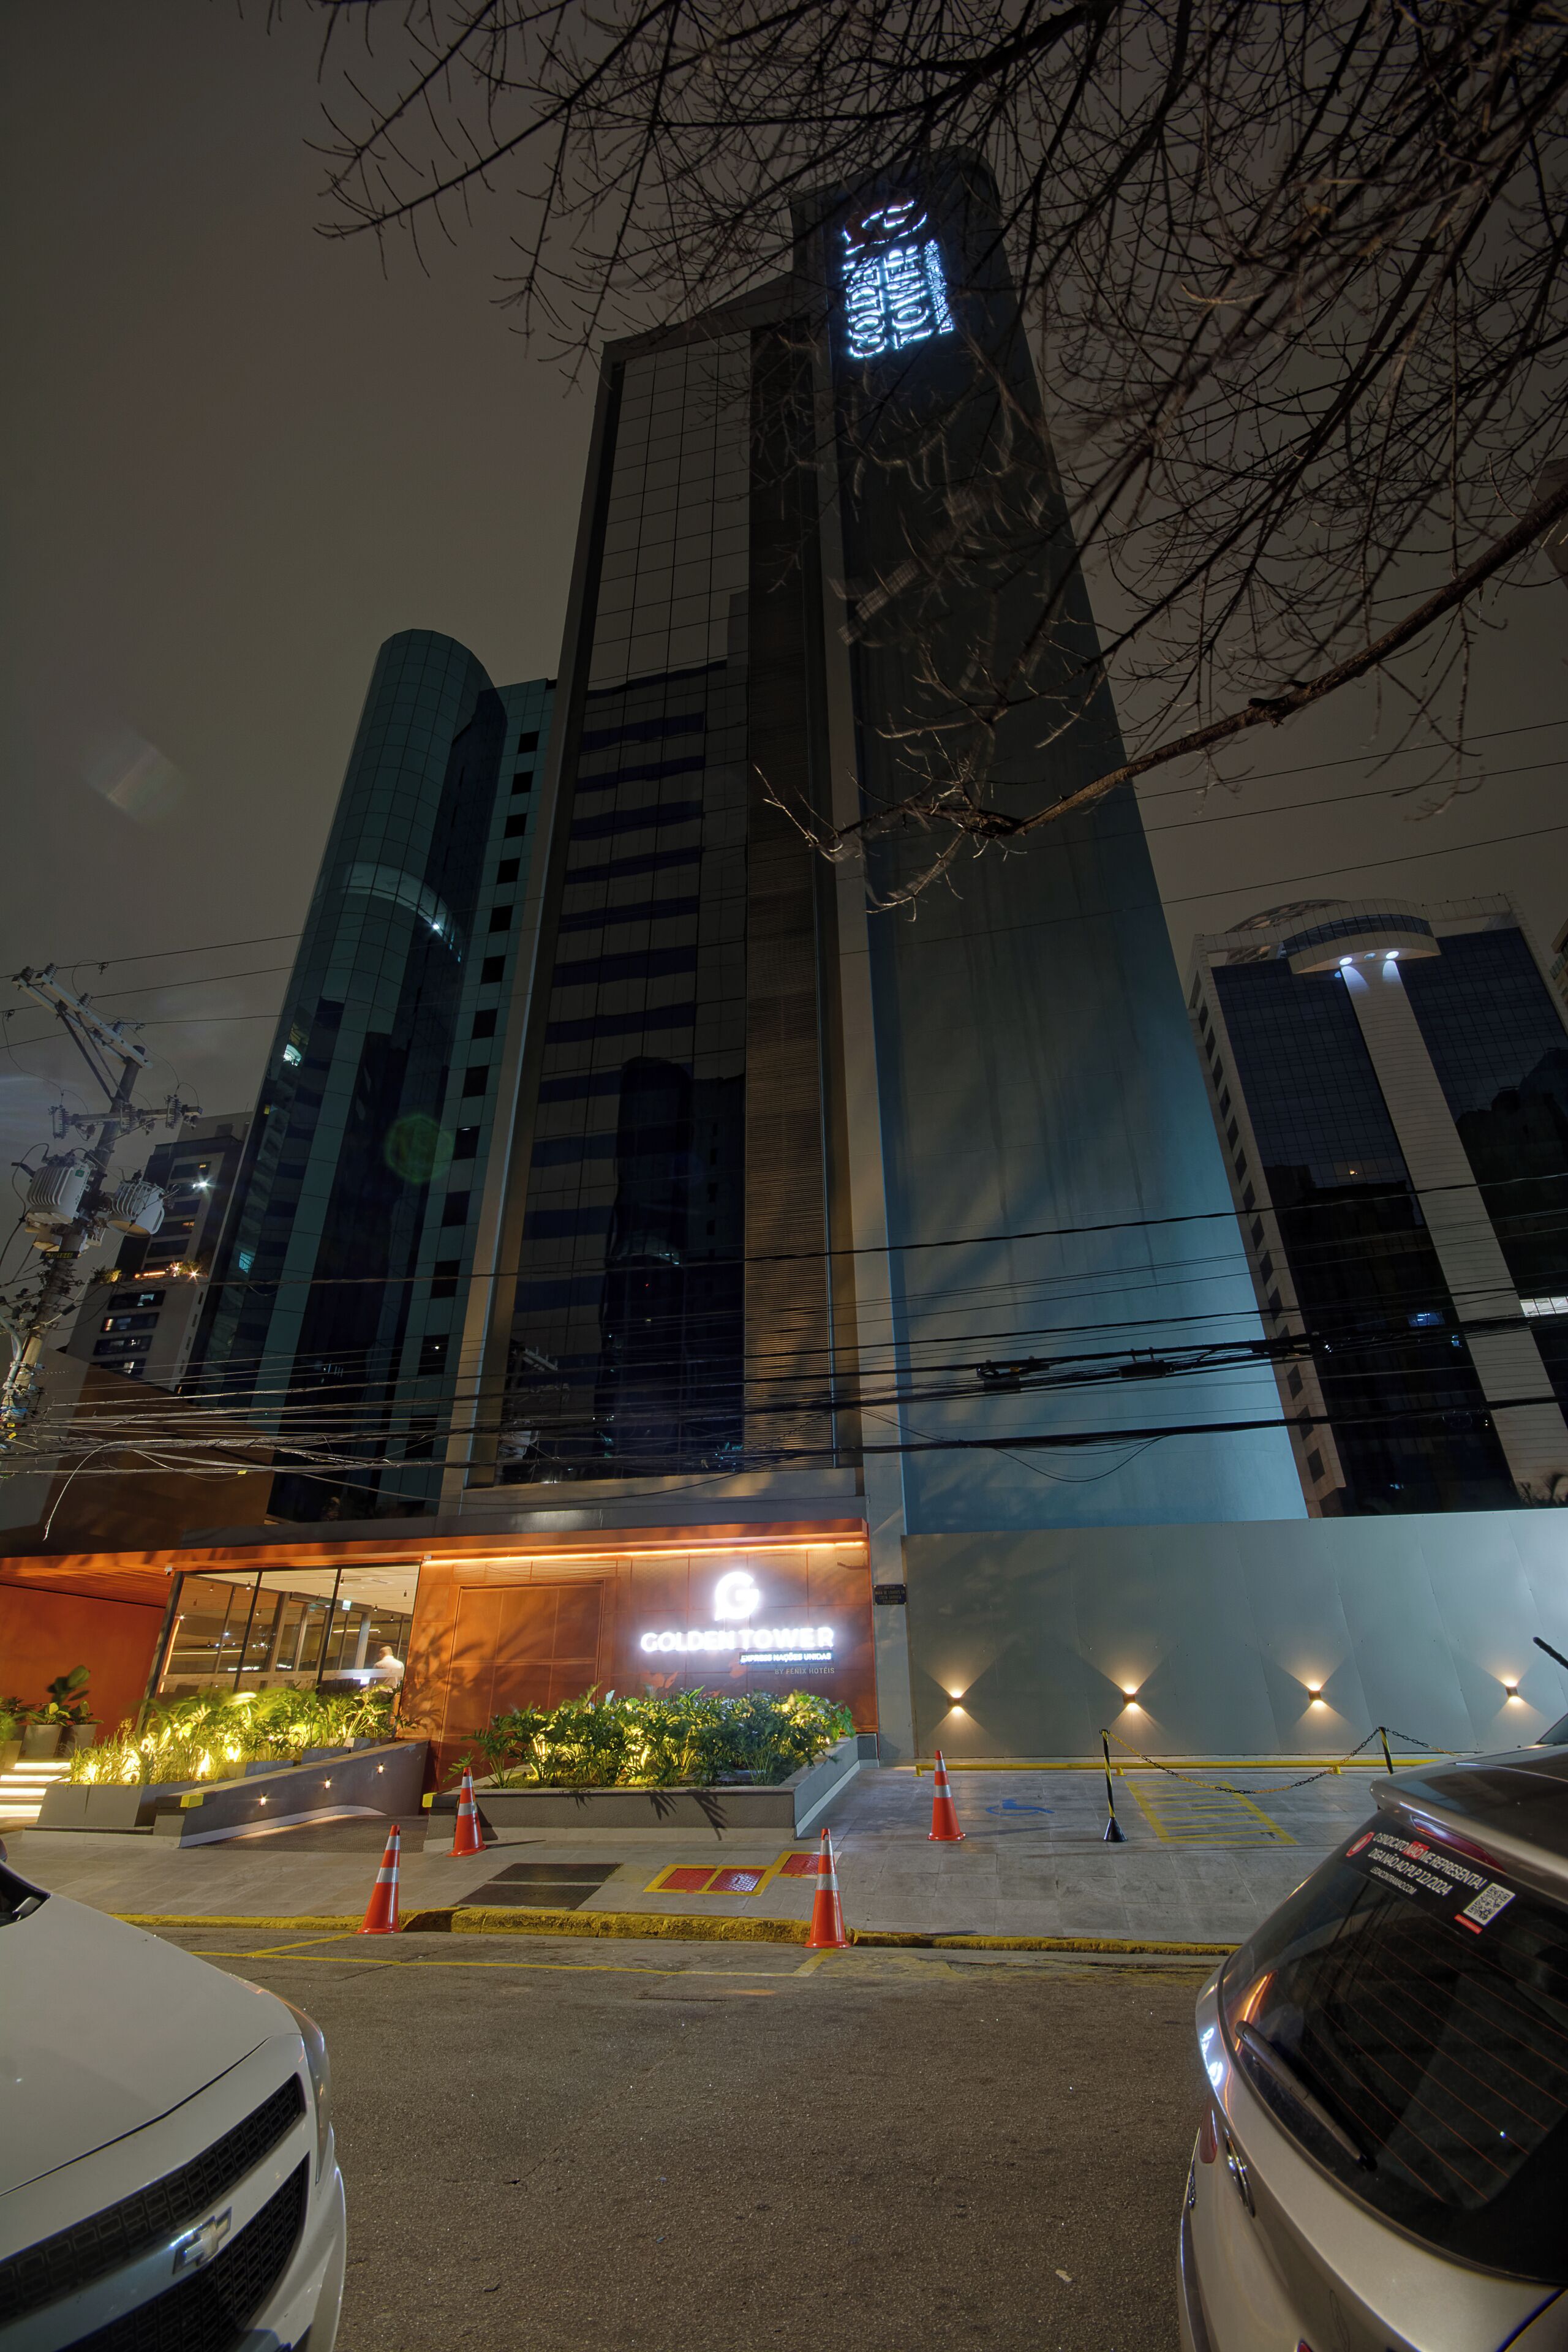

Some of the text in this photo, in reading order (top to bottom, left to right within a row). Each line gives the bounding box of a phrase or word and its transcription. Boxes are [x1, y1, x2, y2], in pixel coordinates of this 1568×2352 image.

[843, 255, 888, 358] GOLDEN
[883, 246, 933, 349] TOWER
[641, 1627, 834, 1652] GOLDEN TOWER
[773, 1652, 802, 1662] NAÇÕES
[1368, 1848, 1453, 1896] DIGA NÃO AO PLP 12/2024
[1377, 1834, 1410, 1851] SINDICATO
[1404, 1844, 1424, 1858] NÃO
[1418, 1850, 1436, 1863] ME
[1429, 1856, 1487, 1890] REPRESENTA!
